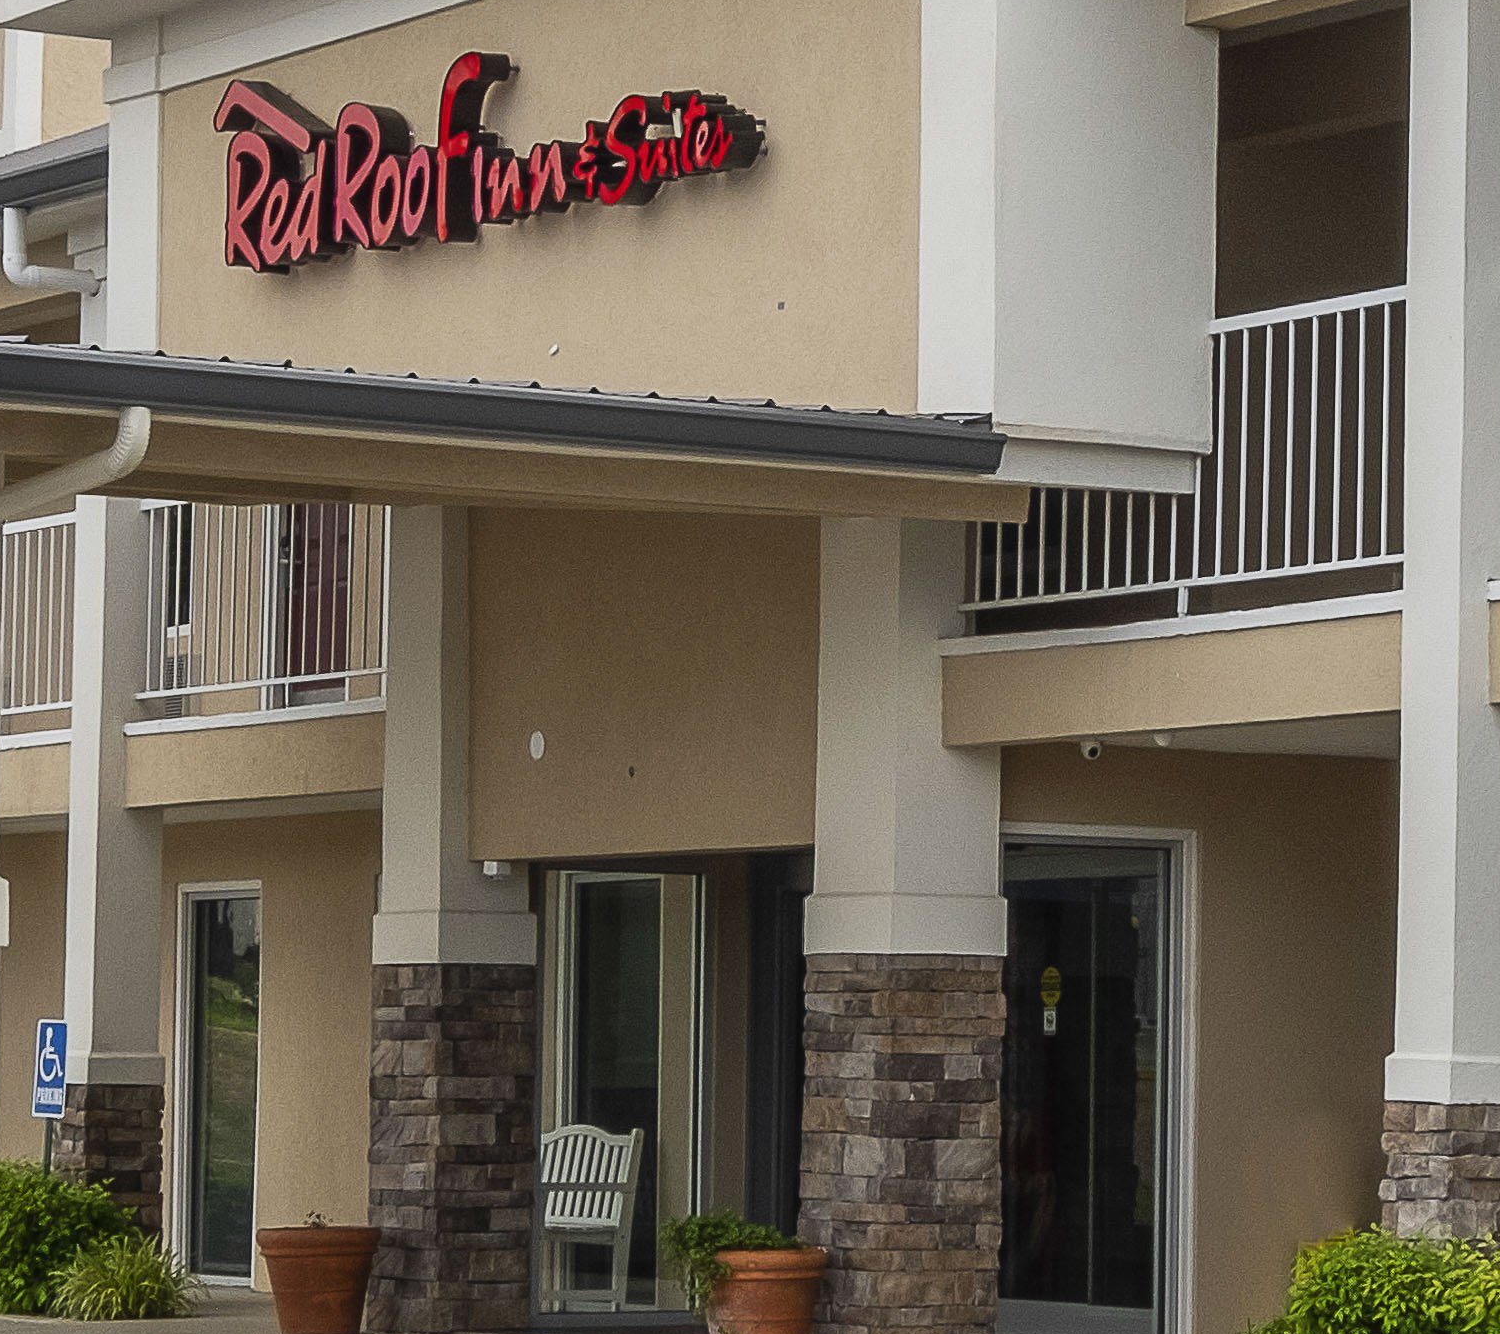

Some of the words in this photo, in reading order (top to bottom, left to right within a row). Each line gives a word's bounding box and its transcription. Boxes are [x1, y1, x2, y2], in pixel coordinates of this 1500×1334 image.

[226, 130, 326, 271] Red
[334, 52, 481, 250] Roof
[473, 141, 567, 223] Inn
[573, 122, 599, 199] &
[599, 93, 734, 205] Suites
